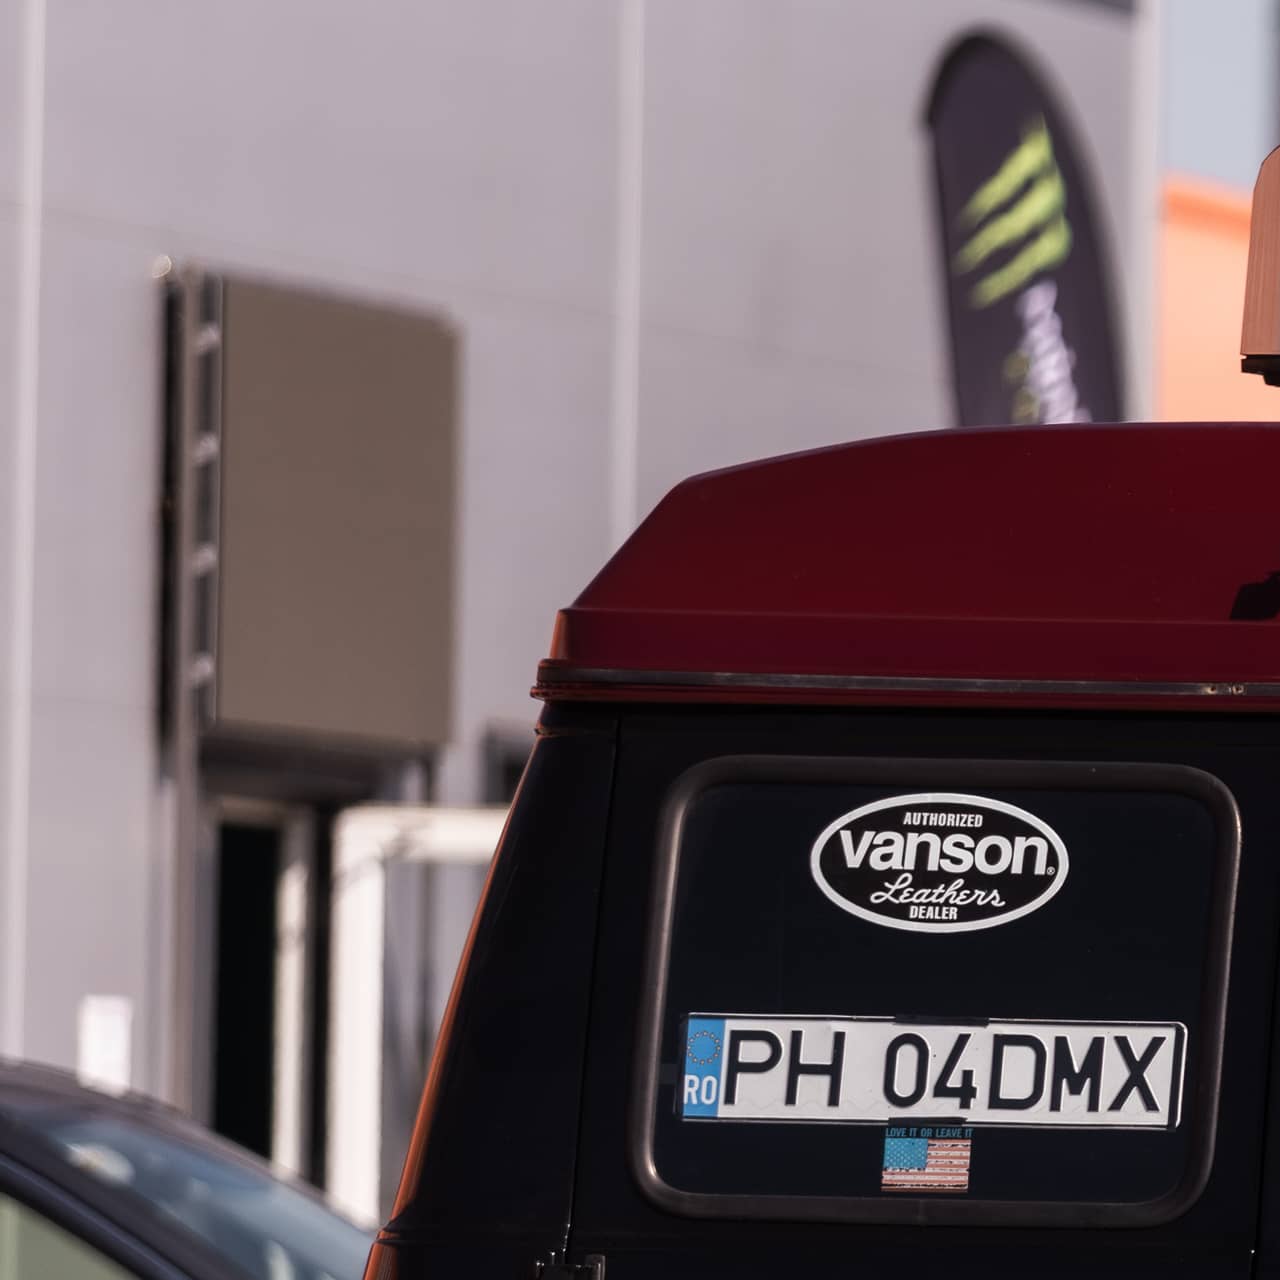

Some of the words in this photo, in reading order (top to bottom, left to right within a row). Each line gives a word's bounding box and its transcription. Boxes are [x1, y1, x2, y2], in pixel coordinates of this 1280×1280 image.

[903, 812, 983, 827] AUTHORIZED
[840, 830, 1049, 875] vanson
[870, 873, 1006, 907] Leathers
[909, 906, 958, 920] DEALER
[723, 1030, 846, 1107] PH
[684, 1074, 718, 1105] RO
[885, 1127, 907, 1137] LOVE
[909, 1127, 918, 1137] IT
[920, 1128, 932, 1138] OR
[935, 1128, 962, 1138] LEAVE
[965, 1128, 974, 1138] IT
